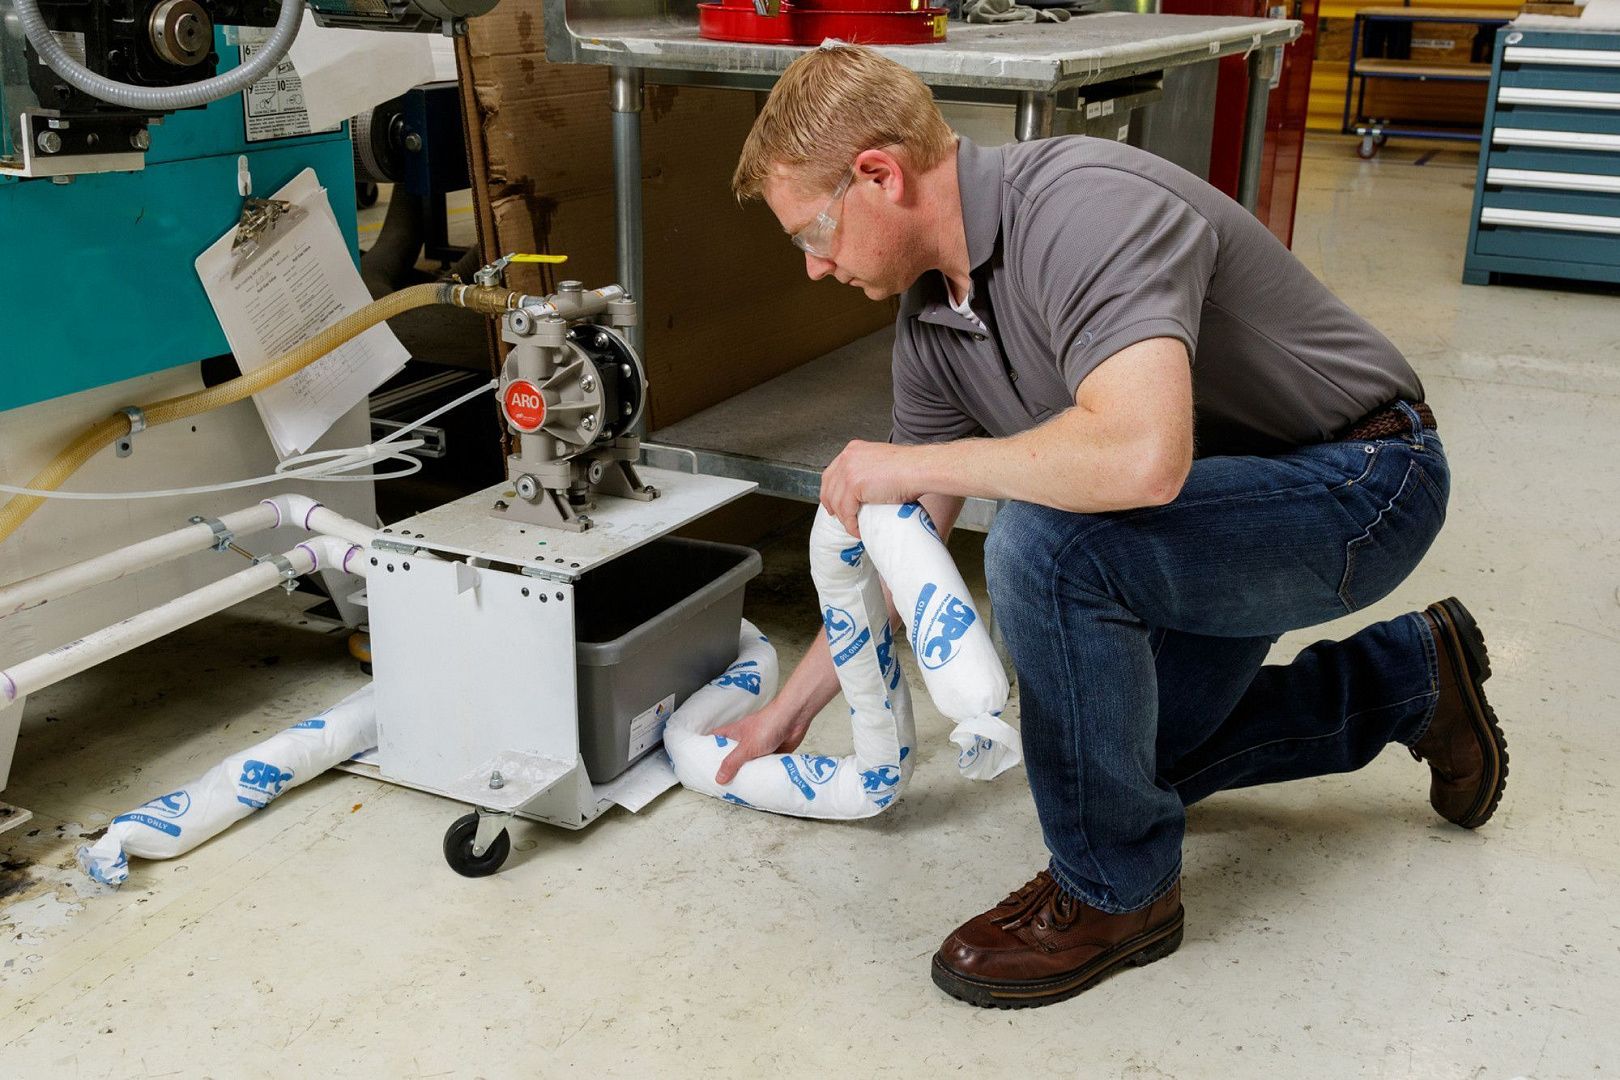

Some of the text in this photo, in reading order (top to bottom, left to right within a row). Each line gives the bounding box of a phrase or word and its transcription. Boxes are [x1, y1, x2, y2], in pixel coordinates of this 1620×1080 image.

[245, 45, 250, 55] 6
[277, 80, 286, 91] 10
[511, 392, 540, 409] ARO
[917, 600, 925, 616] OIL
[924, 596, 977, 662] SPC
[848, 639, 864, 654] ONLY
[239, 759, 293, 793] SPC
[130, 814, 168, 830] OIL ONLY
